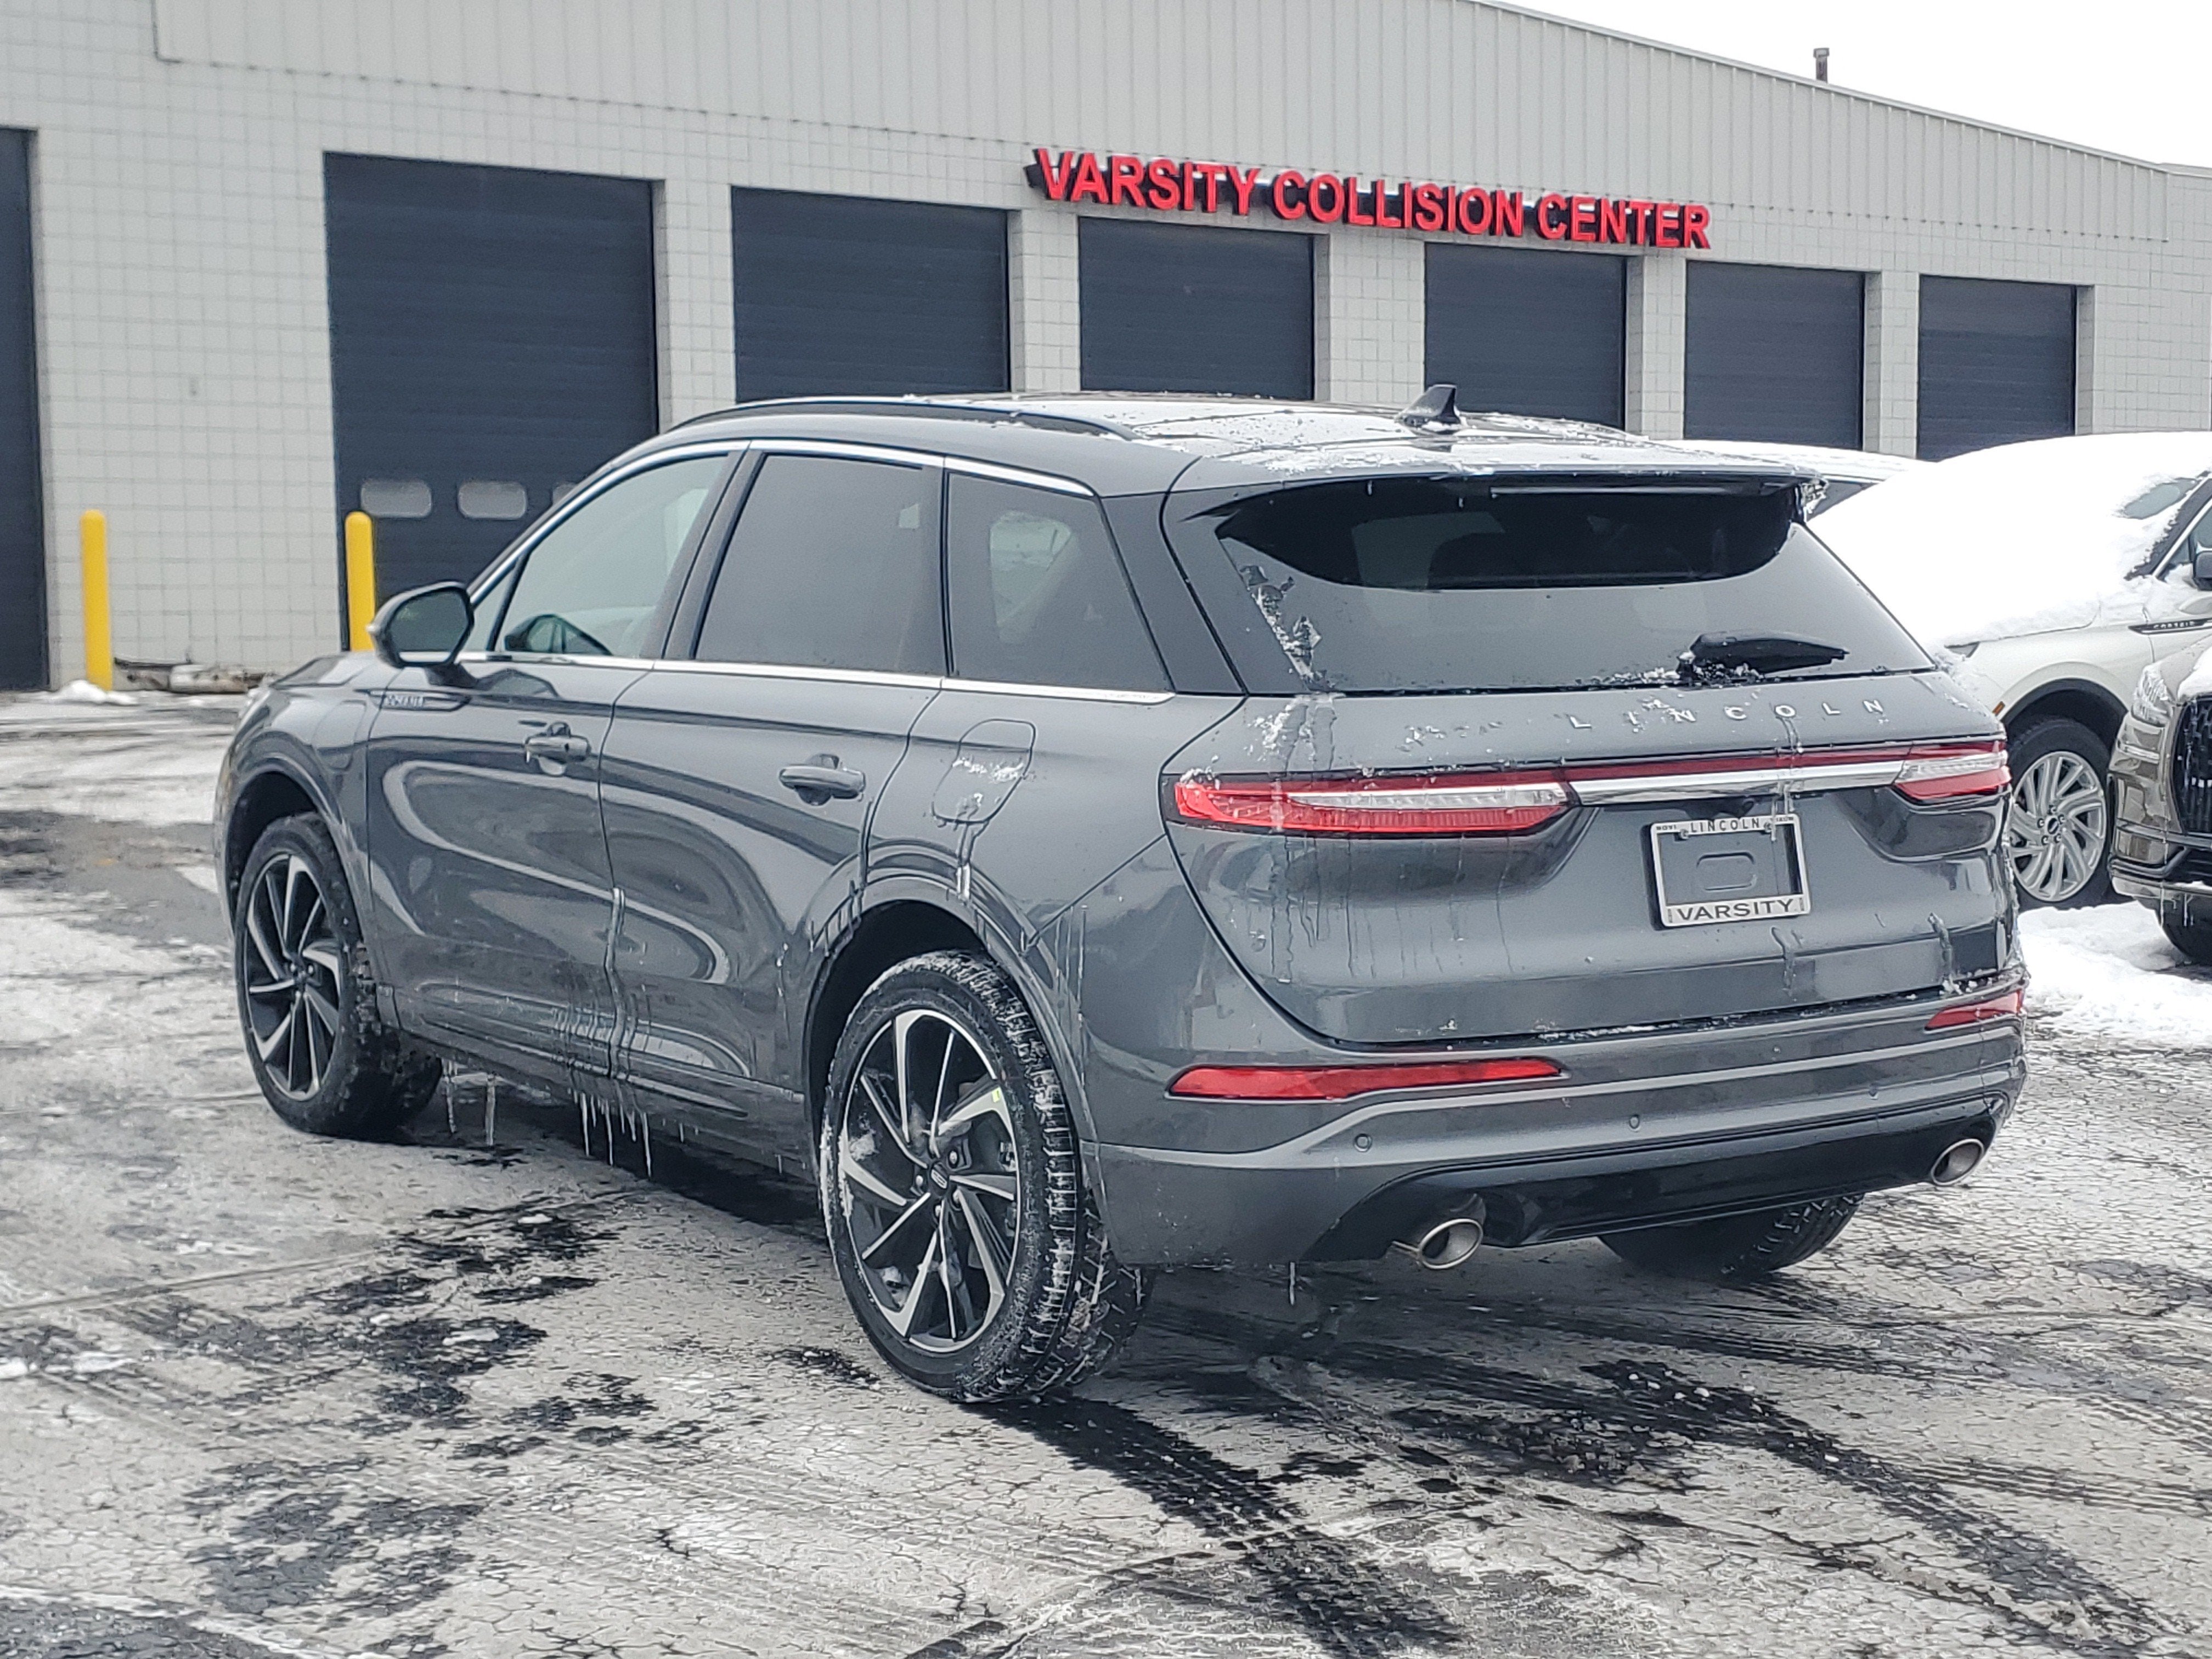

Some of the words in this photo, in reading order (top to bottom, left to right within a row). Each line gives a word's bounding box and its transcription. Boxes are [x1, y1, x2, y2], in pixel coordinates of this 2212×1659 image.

[1036, 148, 1261, 216] VARSITY
[1273, 170, 1525, 238] COLLISION
[1537, 193, 1710, 250] CENTER
[1567, 699, 1884, 729] LINCOLN
[1690, 817, 1760, 833] LINCOLN
[1677, 898, 1794, 921] VARSITY
